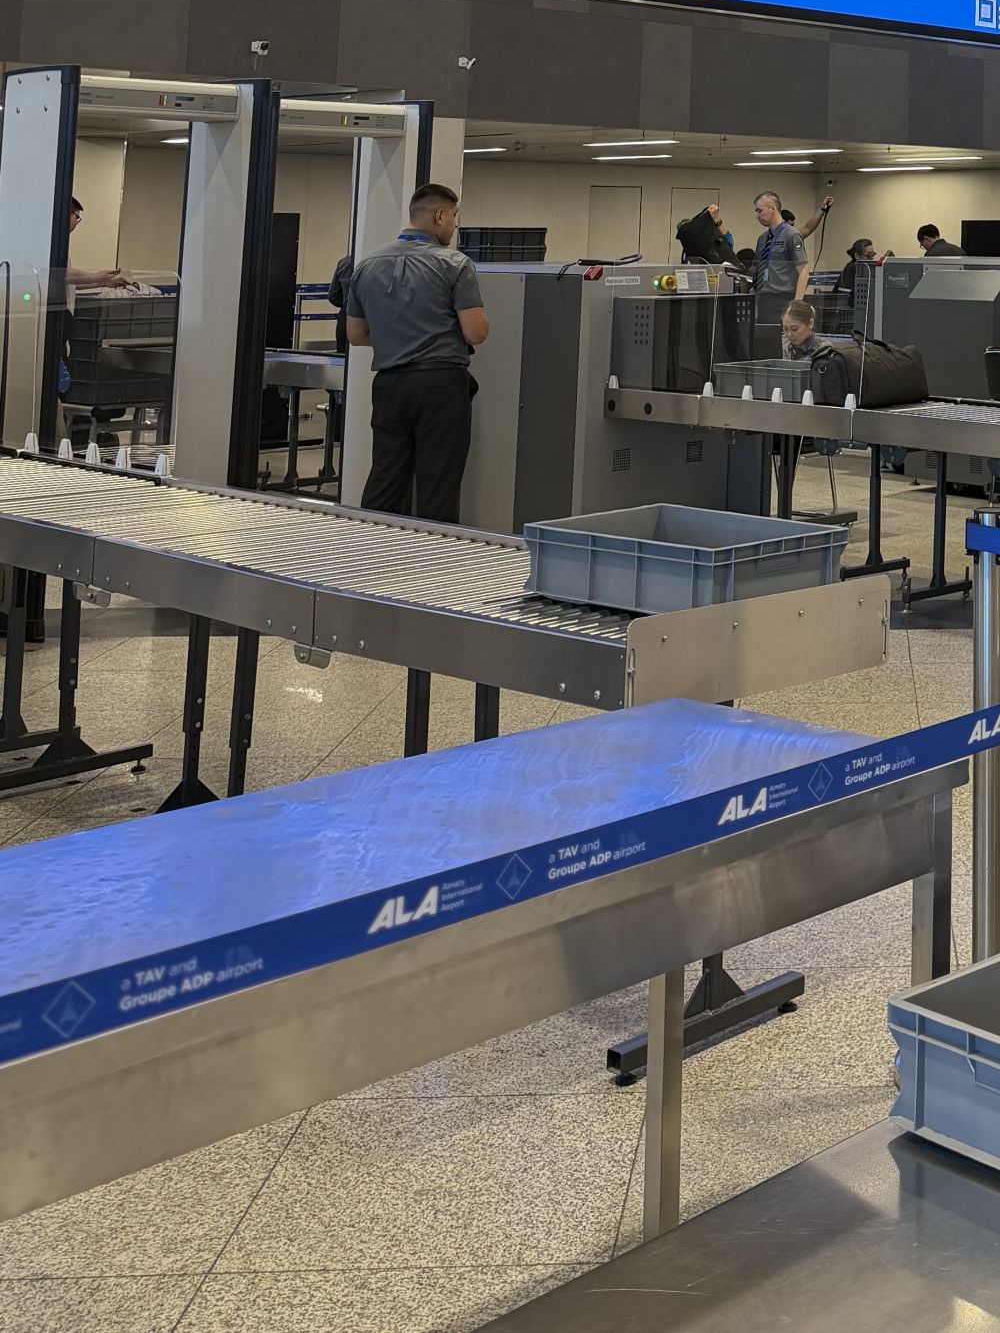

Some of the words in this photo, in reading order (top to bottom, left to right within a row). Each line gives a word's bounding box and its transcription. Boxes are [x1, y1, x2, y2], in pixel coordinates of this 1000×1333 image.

[844, 771, 873, 786] Groupe
[874, 763, 891, 778] ADP
[891, 755, 916, 773] airport
[845, 763, 851, 771] a
[851, 756, 867, 770] TAV
[868, 751, 883, 764] and
[717, 787, 768, 826] ALA
[548, 859, 587, 880] Groupe
[588, 850, 612, 869] ADP
[613, 840, 647, 862] airport
[549, 853, 555, 863] a
[557, 844, 579, 860] TAV
[580, 838, 601, 854] and
[367, 885, 439, 935] ALA
[119, 983, 177, 1012] Groupe
[180, 971, 215, 993] ADP
[216, 957, 264, 982] airport
[120, 978, 131, 991] a
[135, 966, 167, 987] TAV
[169, 956, 197, 978] and
